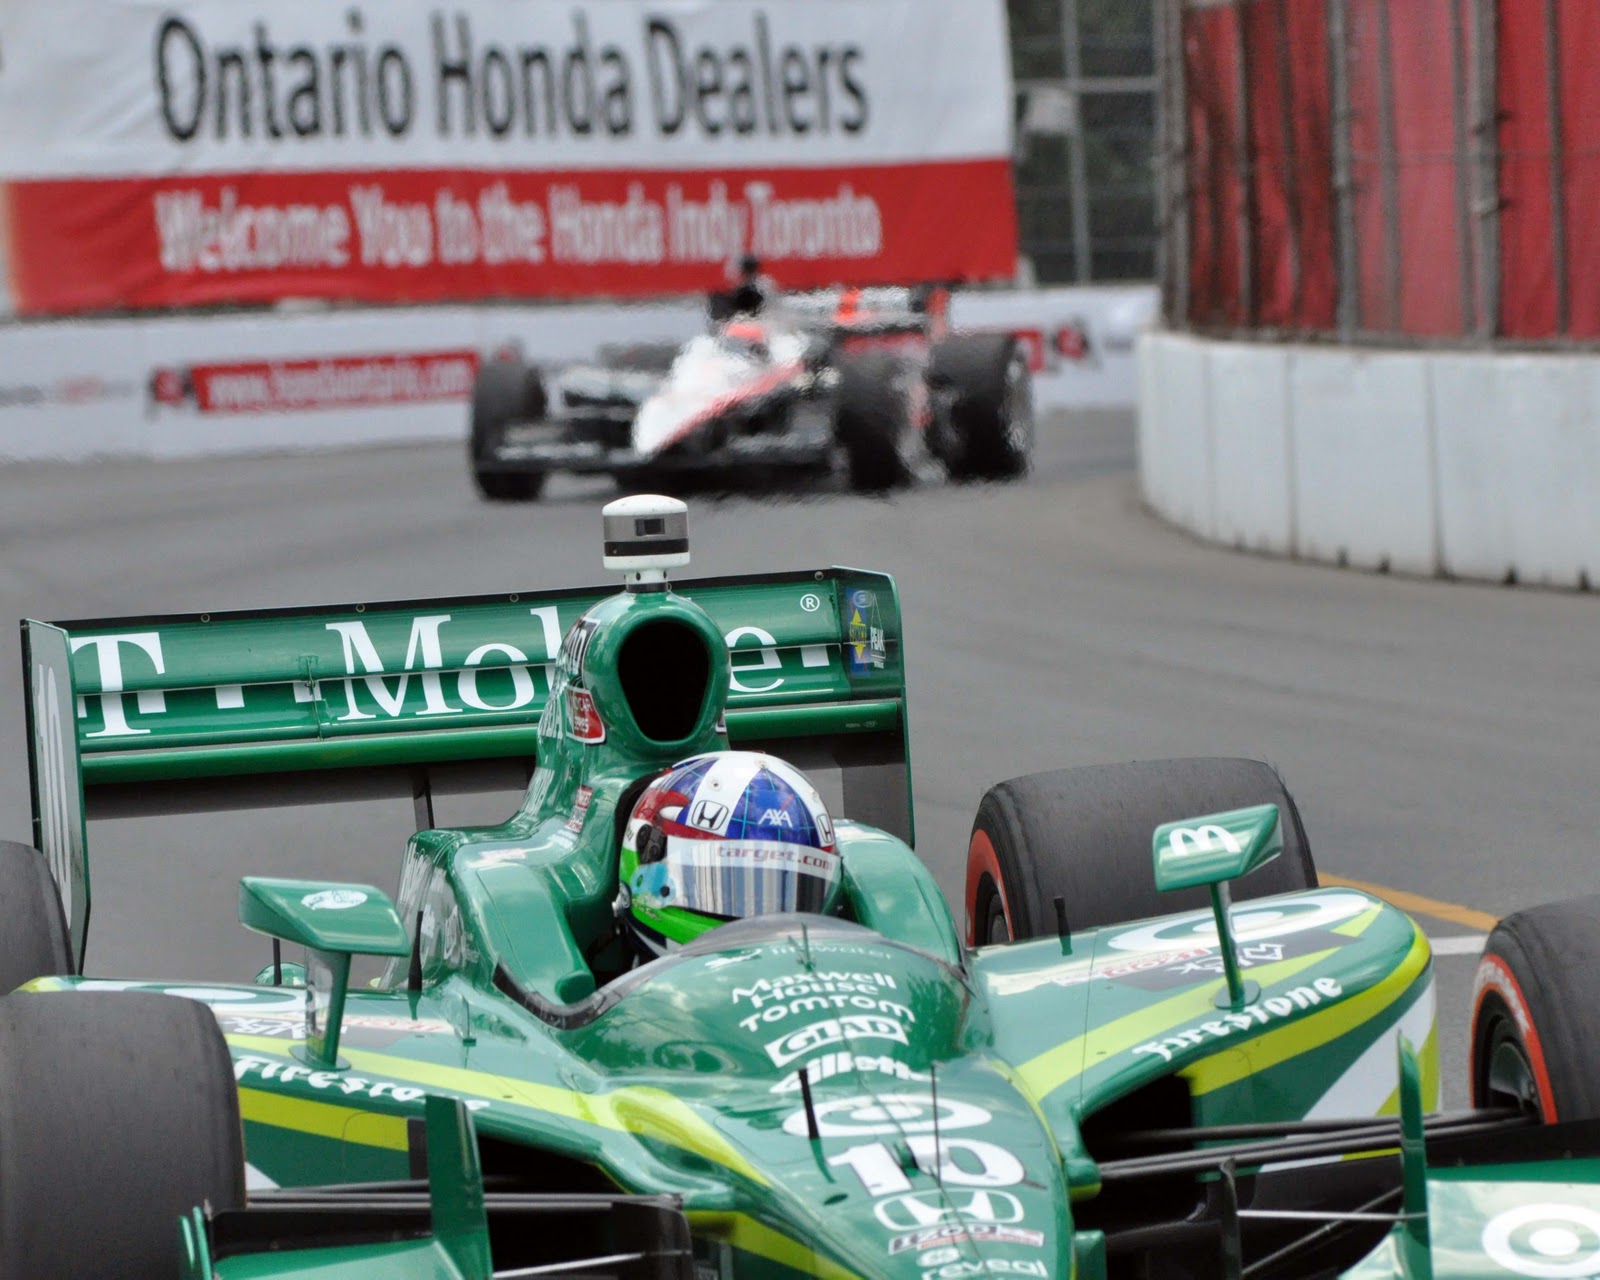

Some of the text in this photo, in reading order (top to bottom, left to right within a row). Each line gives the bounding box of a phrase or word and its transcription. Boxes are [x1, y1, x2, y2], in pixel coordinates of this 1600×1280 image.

[155, 9, 870, 141] Ontario Honda Dealers
[349, 184, 432, 267] You
[434, 188, 479, 265] to
[479, 182, 543, 264] the
[547, 179, 664, 263] Honda
[744, 180, 882, 260] Toronto
[758, 808, 794, 829] AXA
[717, 846, 833, 870] target.com
[732, 971, 897, 1004] Maxwell
[751, 982, 879, 1009] House
[1132, 976, 1343, 1062] Firestone
[234, 1055, 491, 1111] Firestoe
[828, 1135, 1025, 1197] 10
